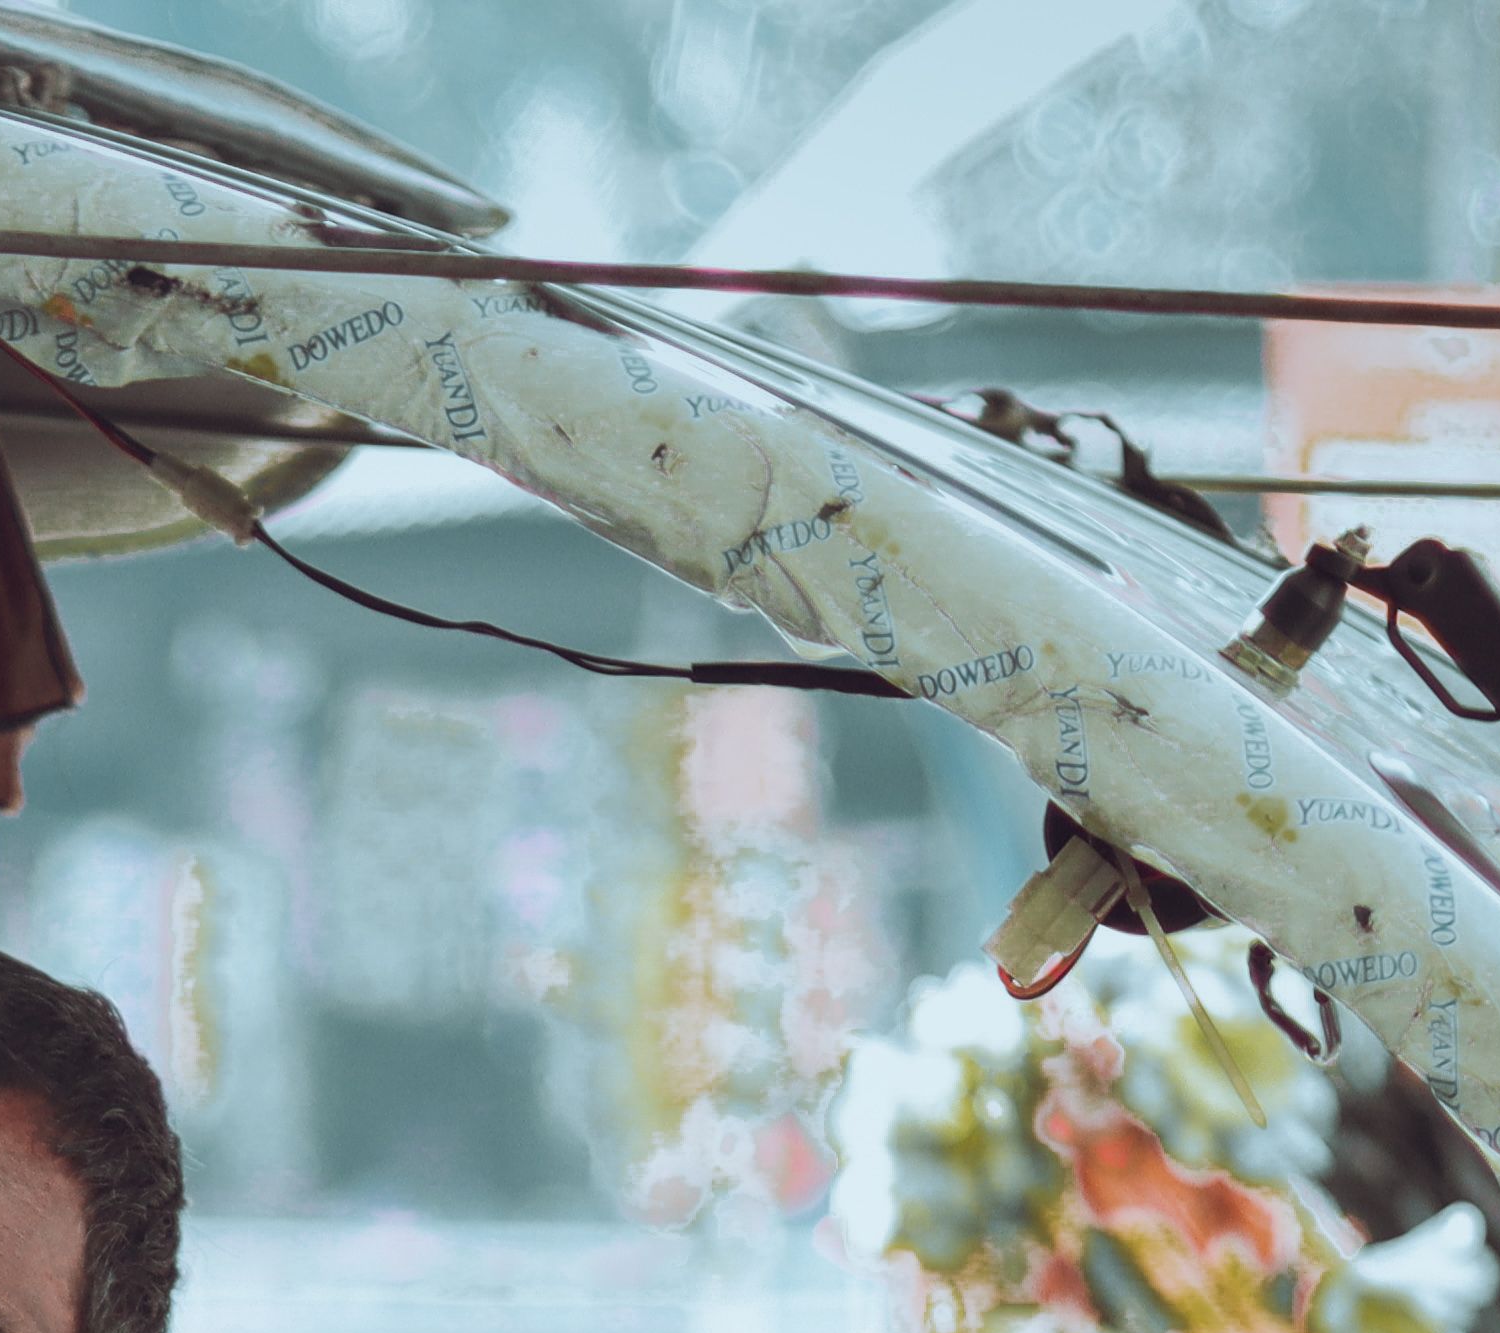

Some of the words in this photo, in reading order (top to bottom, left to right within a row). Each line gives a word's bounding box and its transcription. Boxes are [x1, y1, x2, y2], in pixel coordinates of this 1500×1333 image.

[287, 300, 404, 370] DOWEDO
[425, 331, 488, 442] YUANDI
[917, 644, 1035, 700] DOWEDO
[1049, 685, 1089, 800] YUANDI
